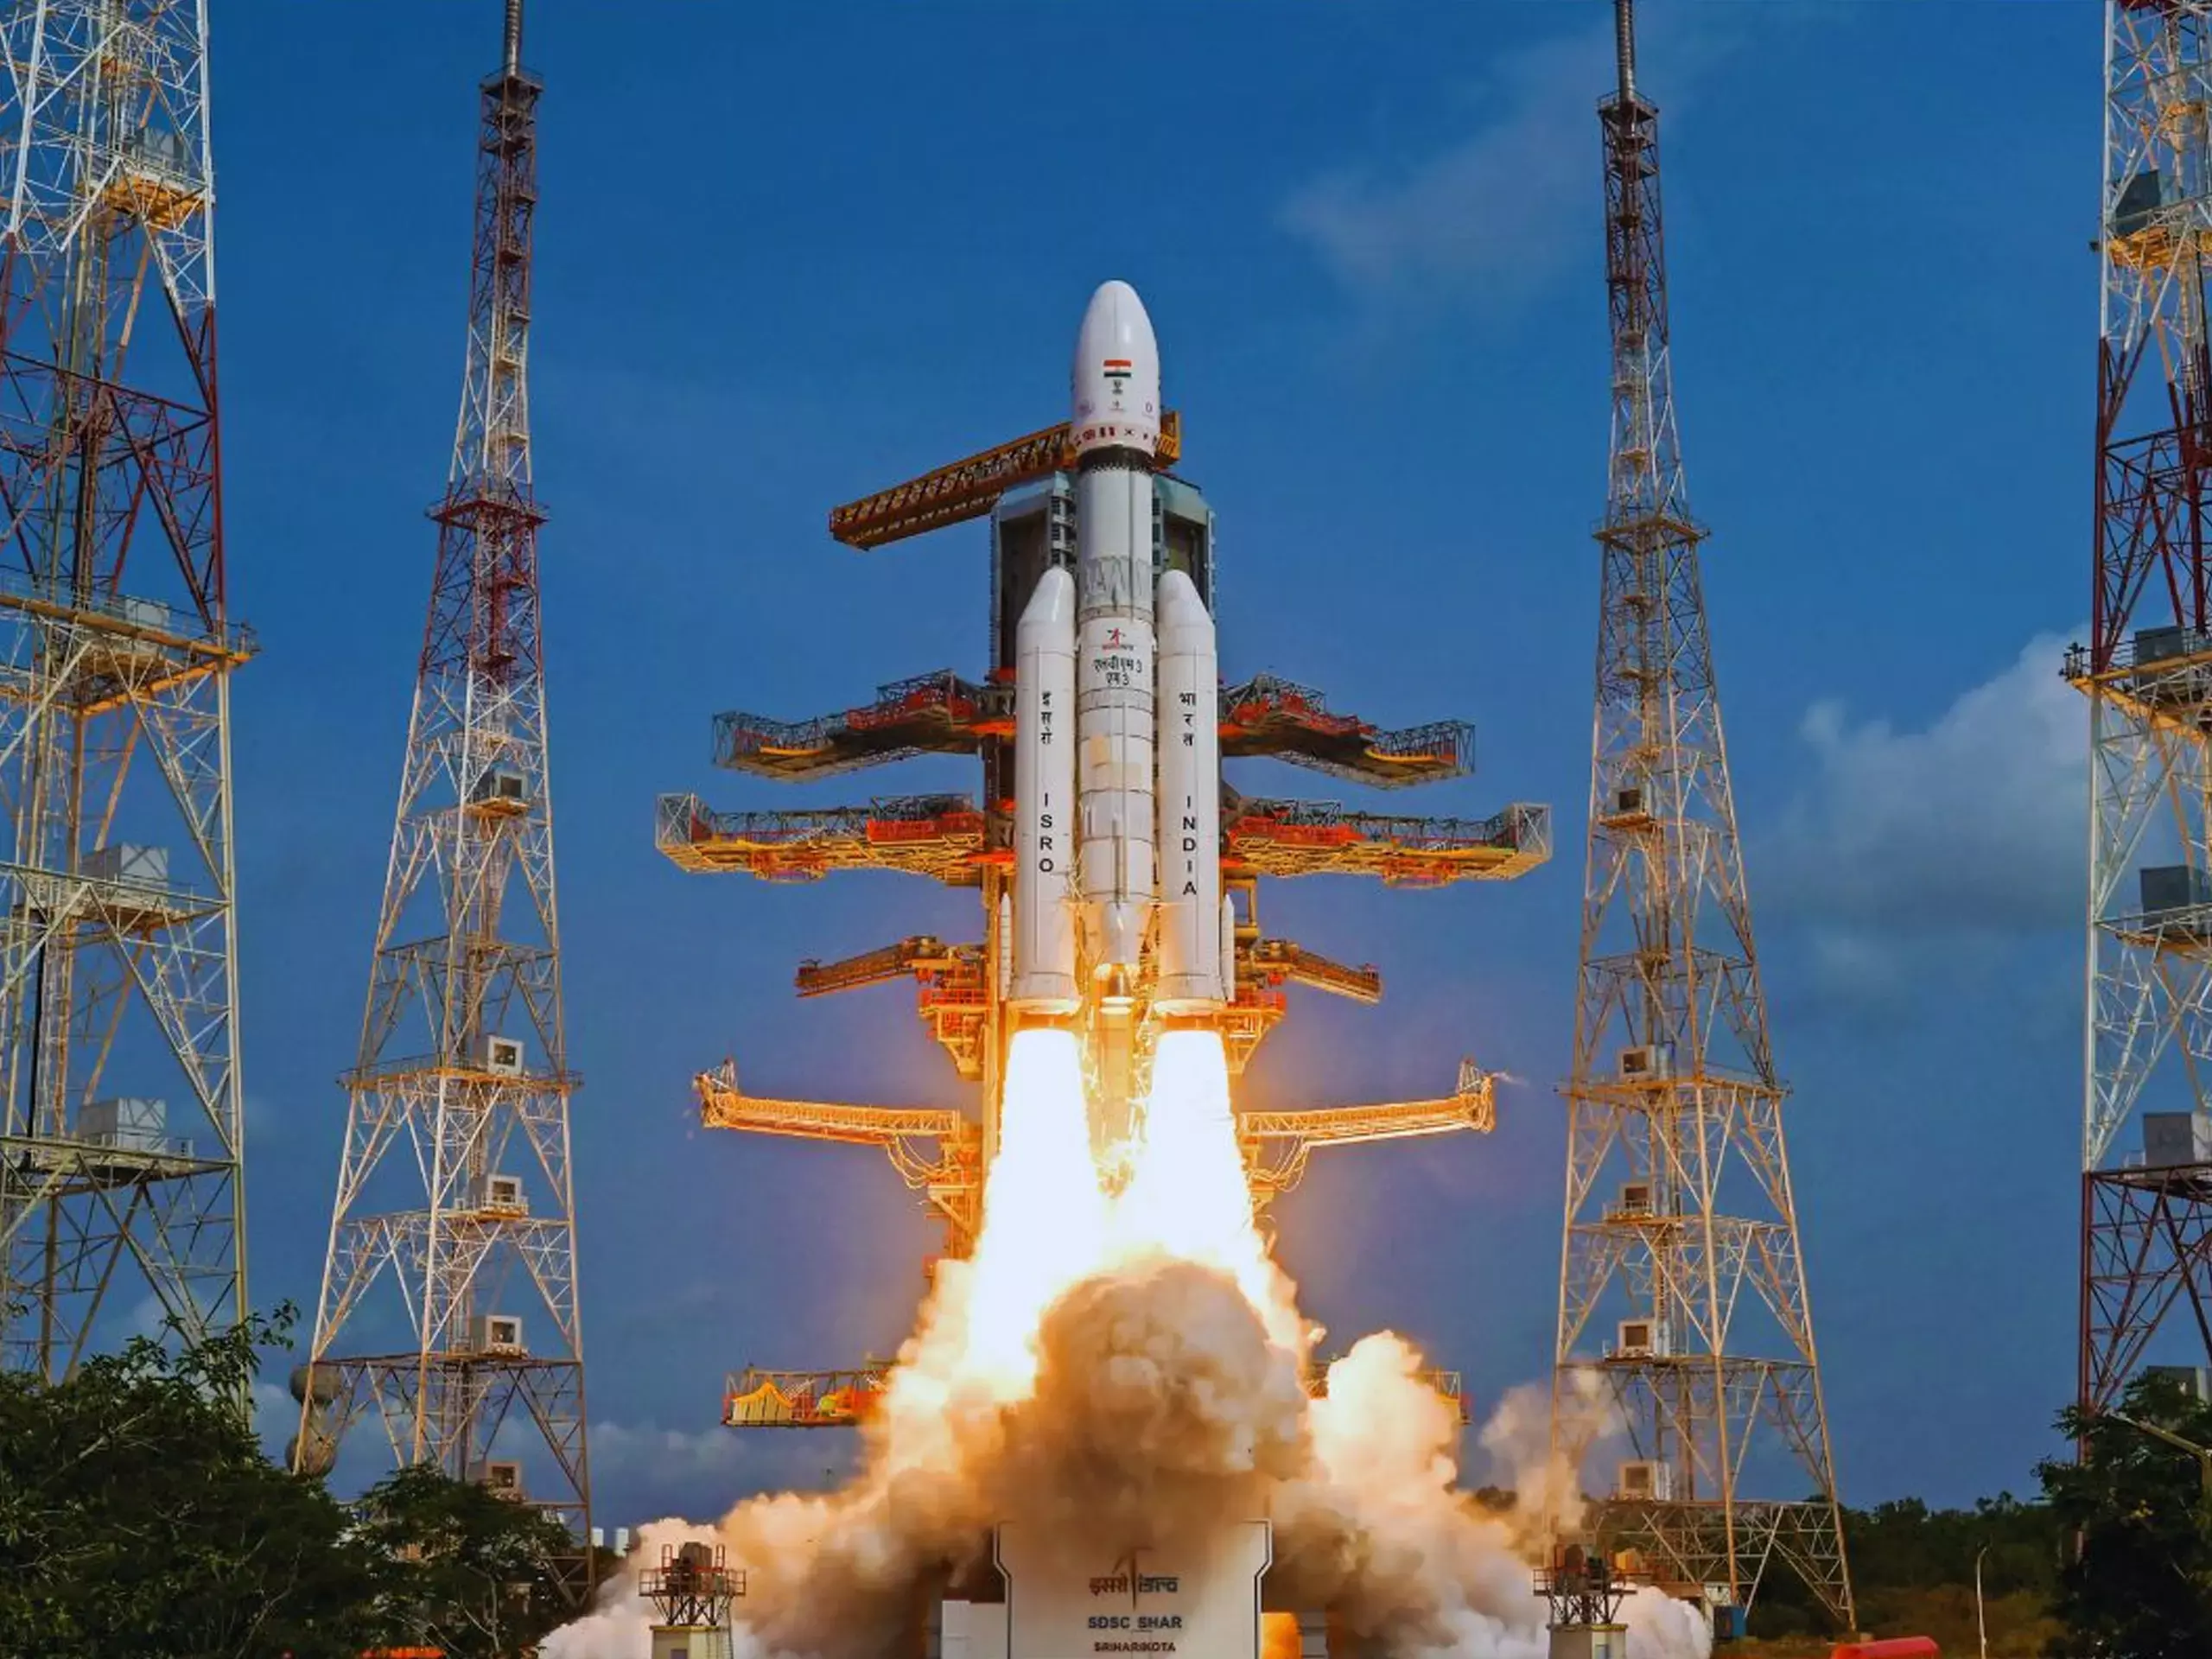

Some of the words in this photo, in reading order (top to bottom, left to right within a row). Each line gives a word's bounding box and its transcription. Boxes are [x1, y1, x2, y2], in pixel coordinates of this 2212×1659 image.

[1039, 792, 1054, 873] ISRO
[1182, 795, 1198, 895] INDIA
[1089, 1617, 1130, 1629] SDSC
[1137, 1617, 1182, 1629] SHAR
[1094, 1642, 1176, 1652] SRIHARIKOTA
